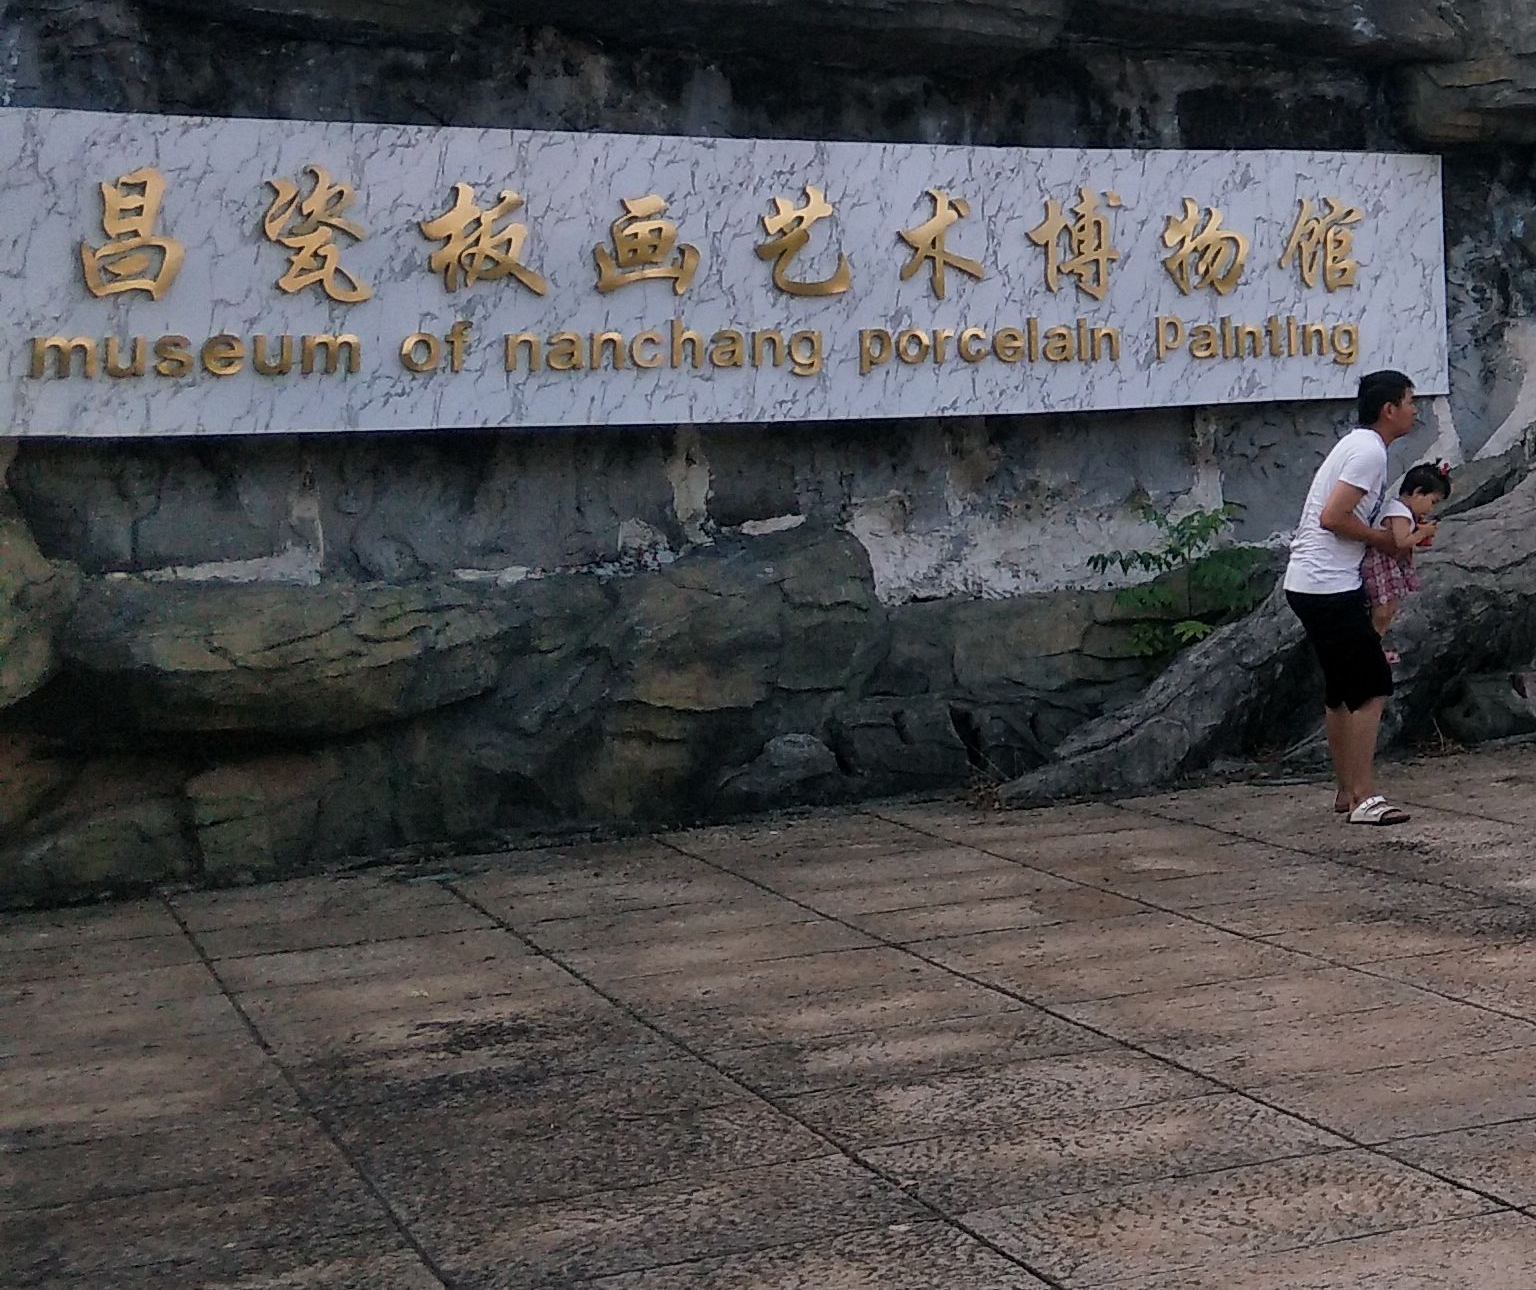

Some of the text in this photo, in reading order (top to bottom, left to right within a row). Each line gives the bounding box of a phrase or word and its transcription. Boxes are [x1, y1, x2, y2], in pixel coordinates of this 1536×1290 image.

[80, 164, 1364, 304] 昌瓷板画艺术博物馆
[30, 332, 361, 379] museum
[400, 320, 473, 373] of
[504, 317, 823, 377] nanchang
[859, 317, 1121, 377] porcelain
